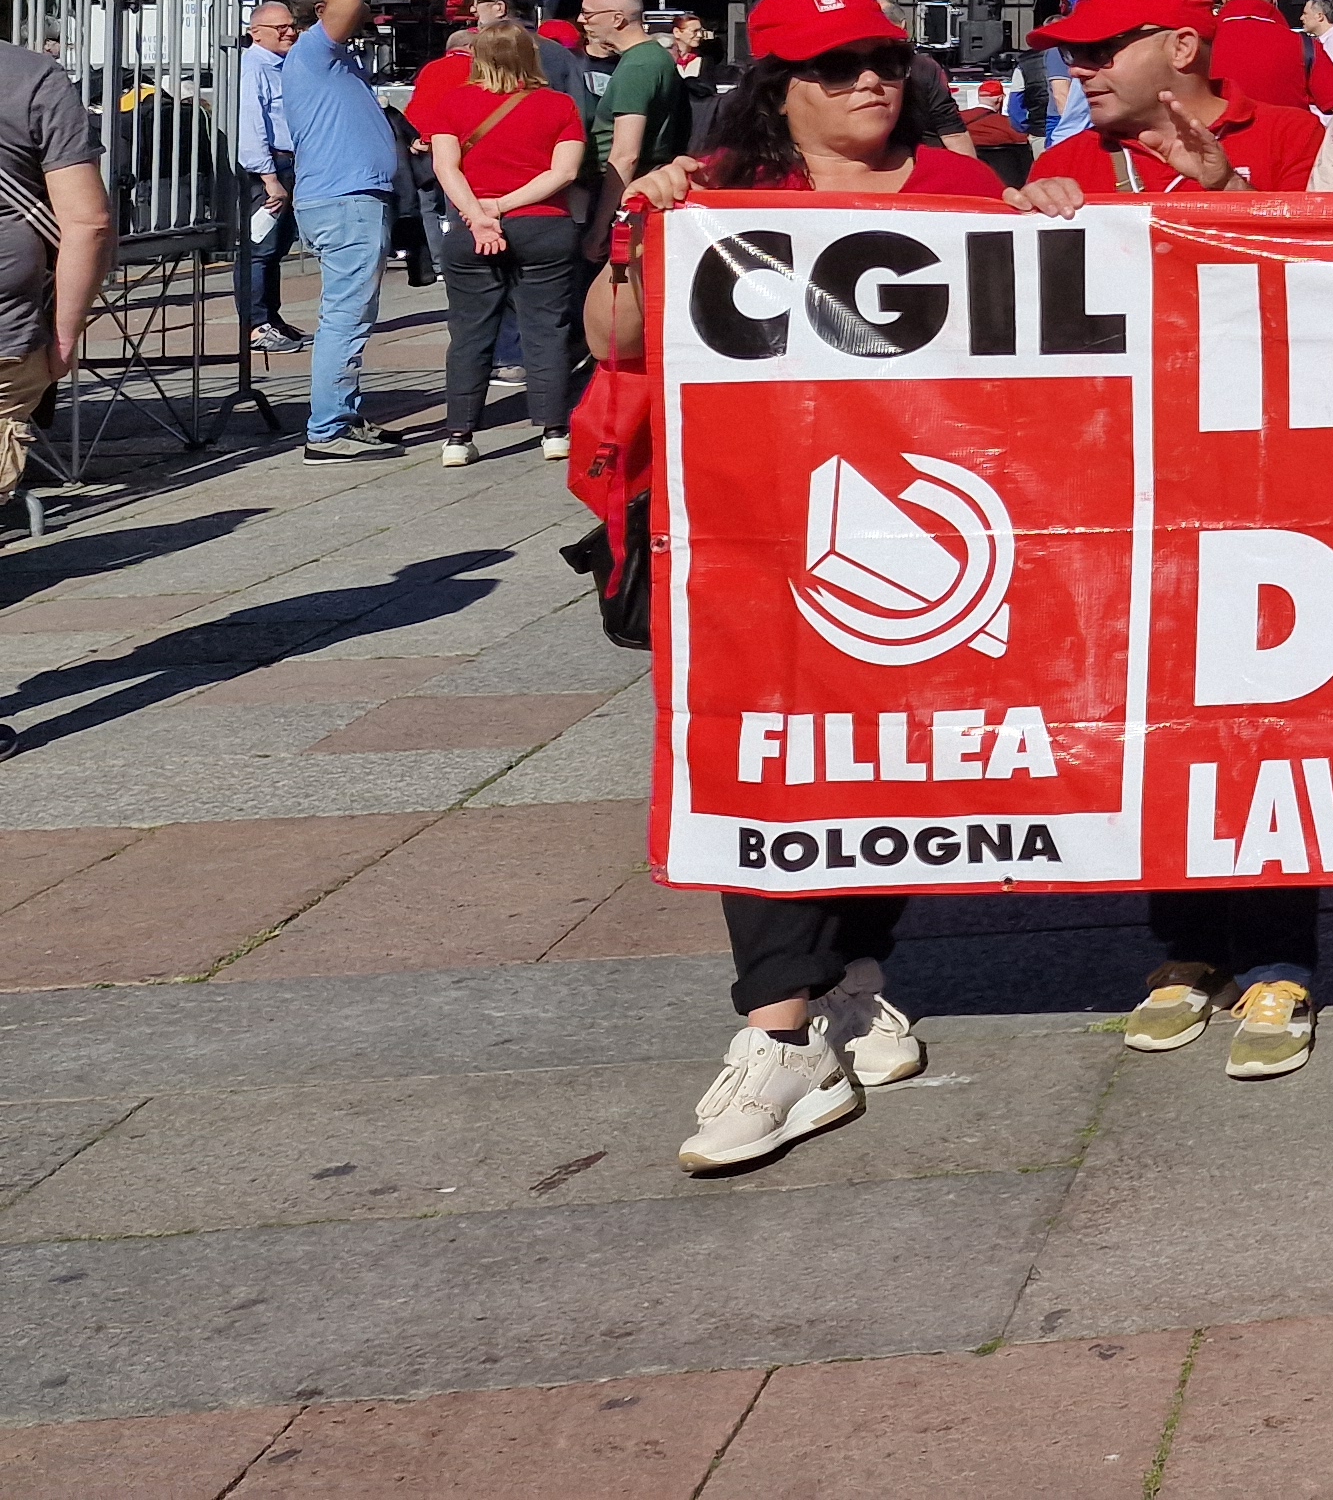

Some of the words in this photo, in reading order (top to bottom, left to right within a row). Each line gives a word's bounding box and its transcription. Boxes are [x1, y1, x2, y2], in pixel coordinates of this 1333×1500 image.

[691, 228, 1127, 360] CGIL
[738, 707, 1058, 786] FILLEA
[739, 823, 1062, 873] BOLOGNA
